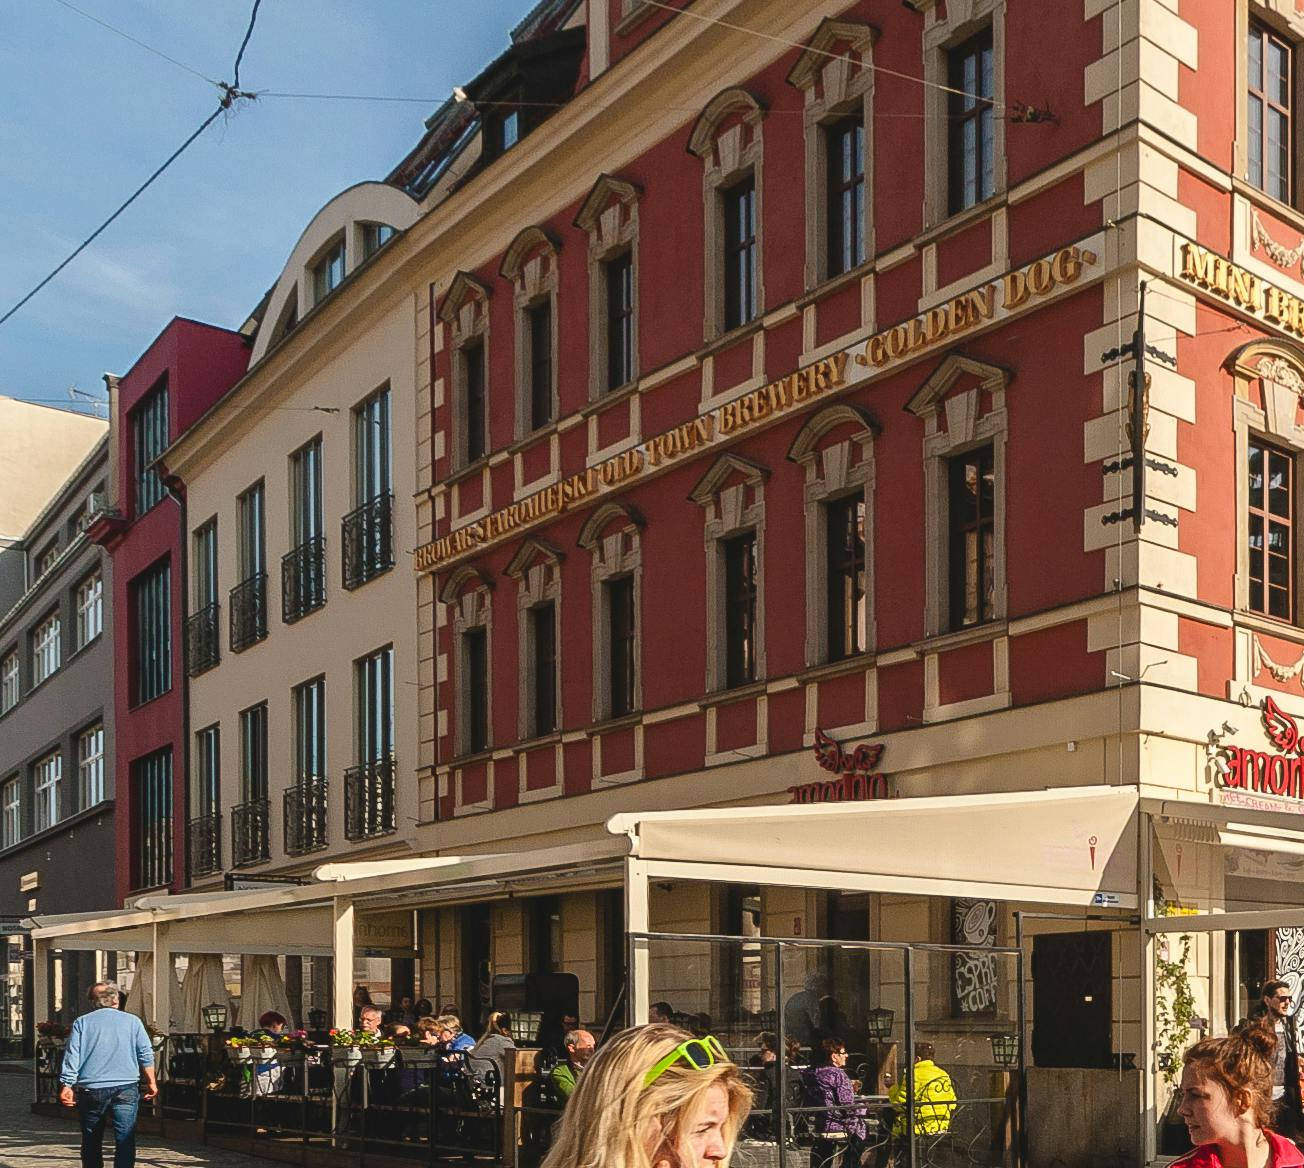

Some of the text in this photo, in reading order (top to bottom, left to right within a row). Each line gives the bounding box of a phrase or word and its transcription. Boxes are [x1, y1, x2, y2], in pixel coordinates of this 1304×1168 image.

[1183, 242, 1262, 314] MINI
[414, 527, 474, 571] BROWAR
[600, 449, 645, 486] OLD
[646, 414, 716, 466] TOWN
[719, 351, 850, 434] BREWERY
